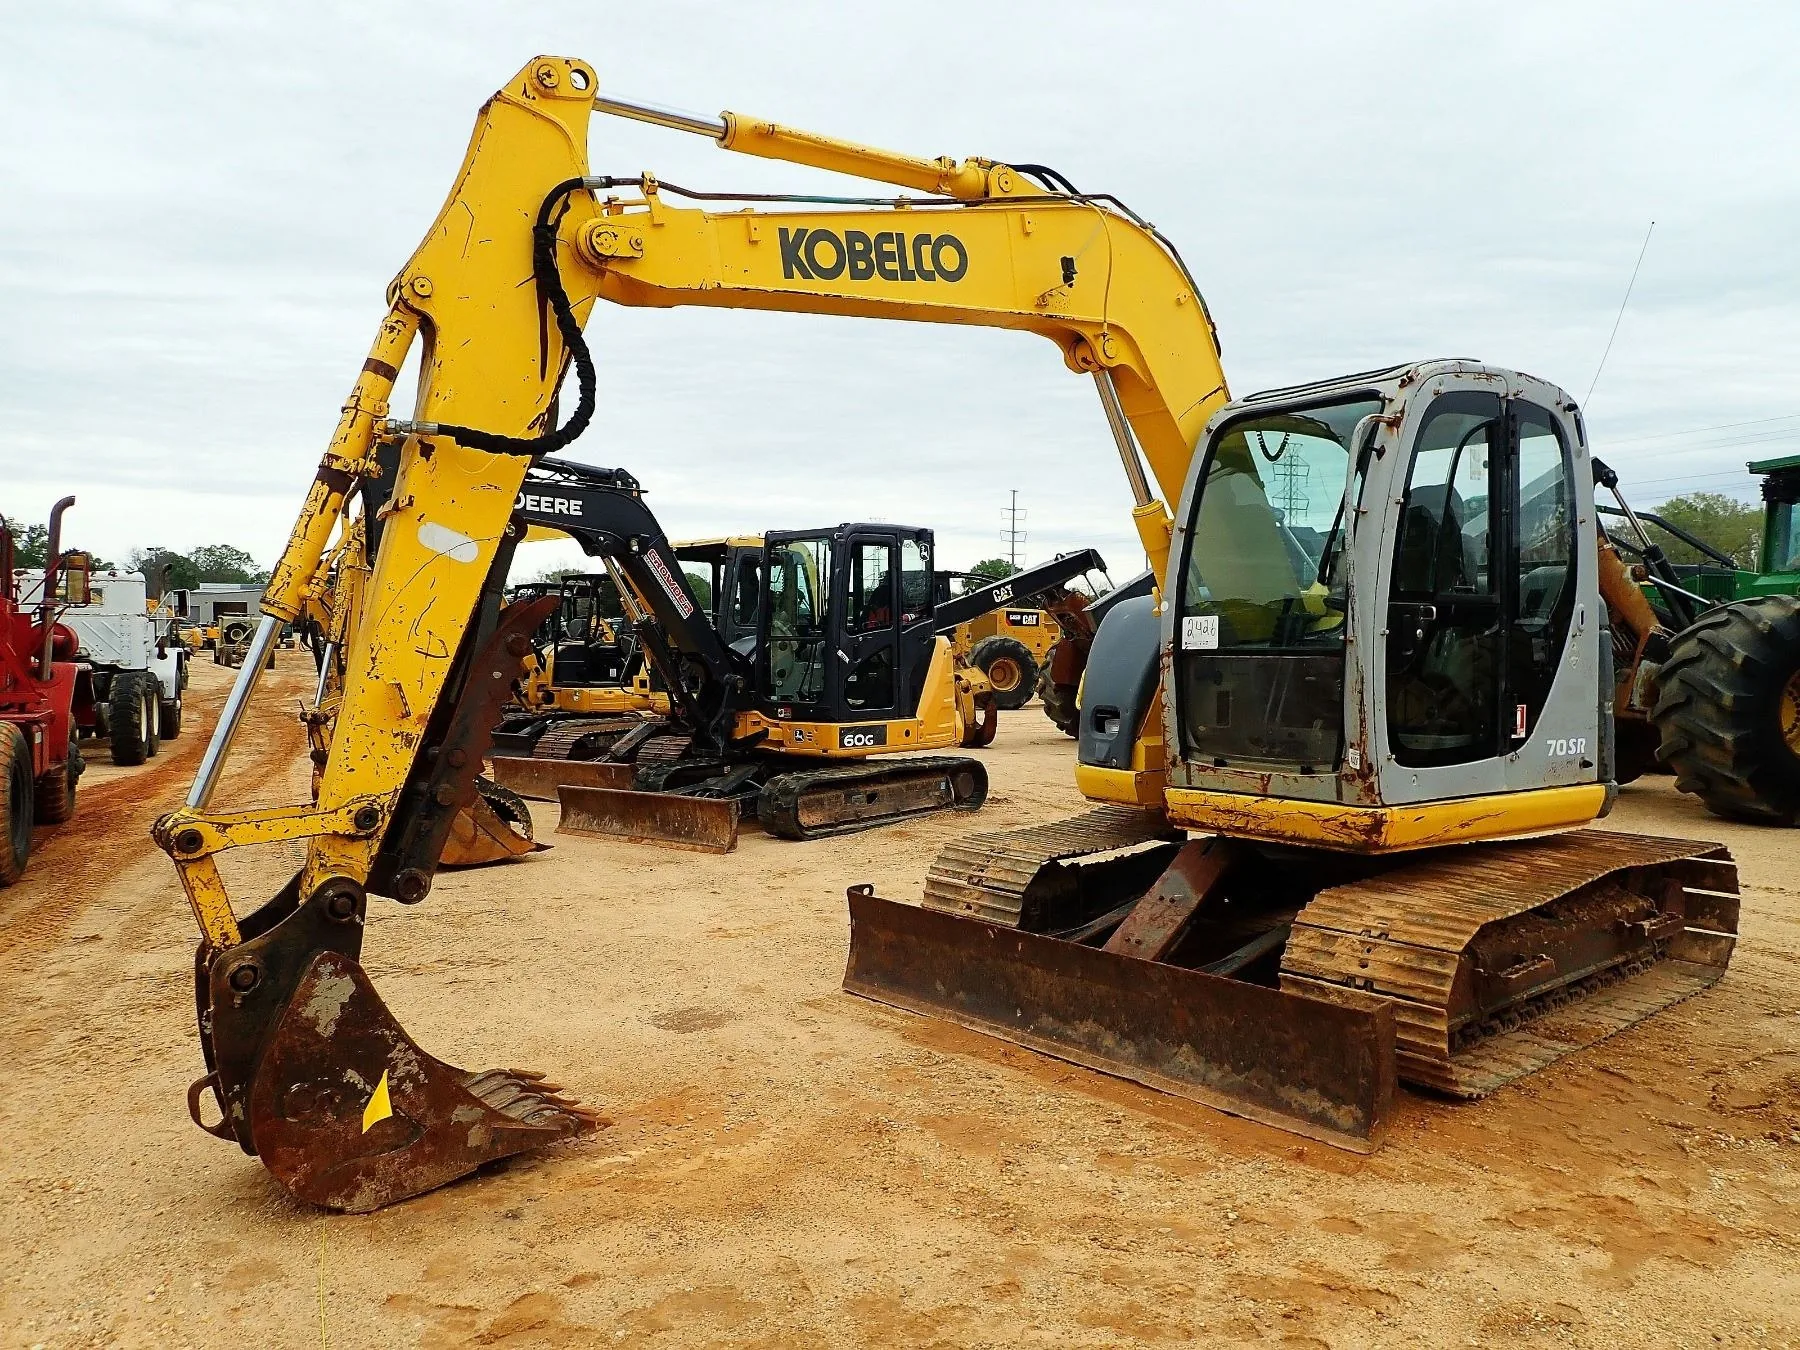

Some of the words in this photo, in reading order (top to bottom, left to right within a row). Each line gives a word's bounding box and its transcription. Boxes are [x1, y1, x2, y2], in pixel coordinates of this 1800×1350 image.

[778, 227, 969, 283] KOBELCO
[647, 548, 693, 616] CROWDER
[992, 584, 1014, 602] CAT
[1022, 614, 1038, 625] CAT
[843, 733, 874, 747] 60G
[1546, 737, 1587, 757] 70SR
